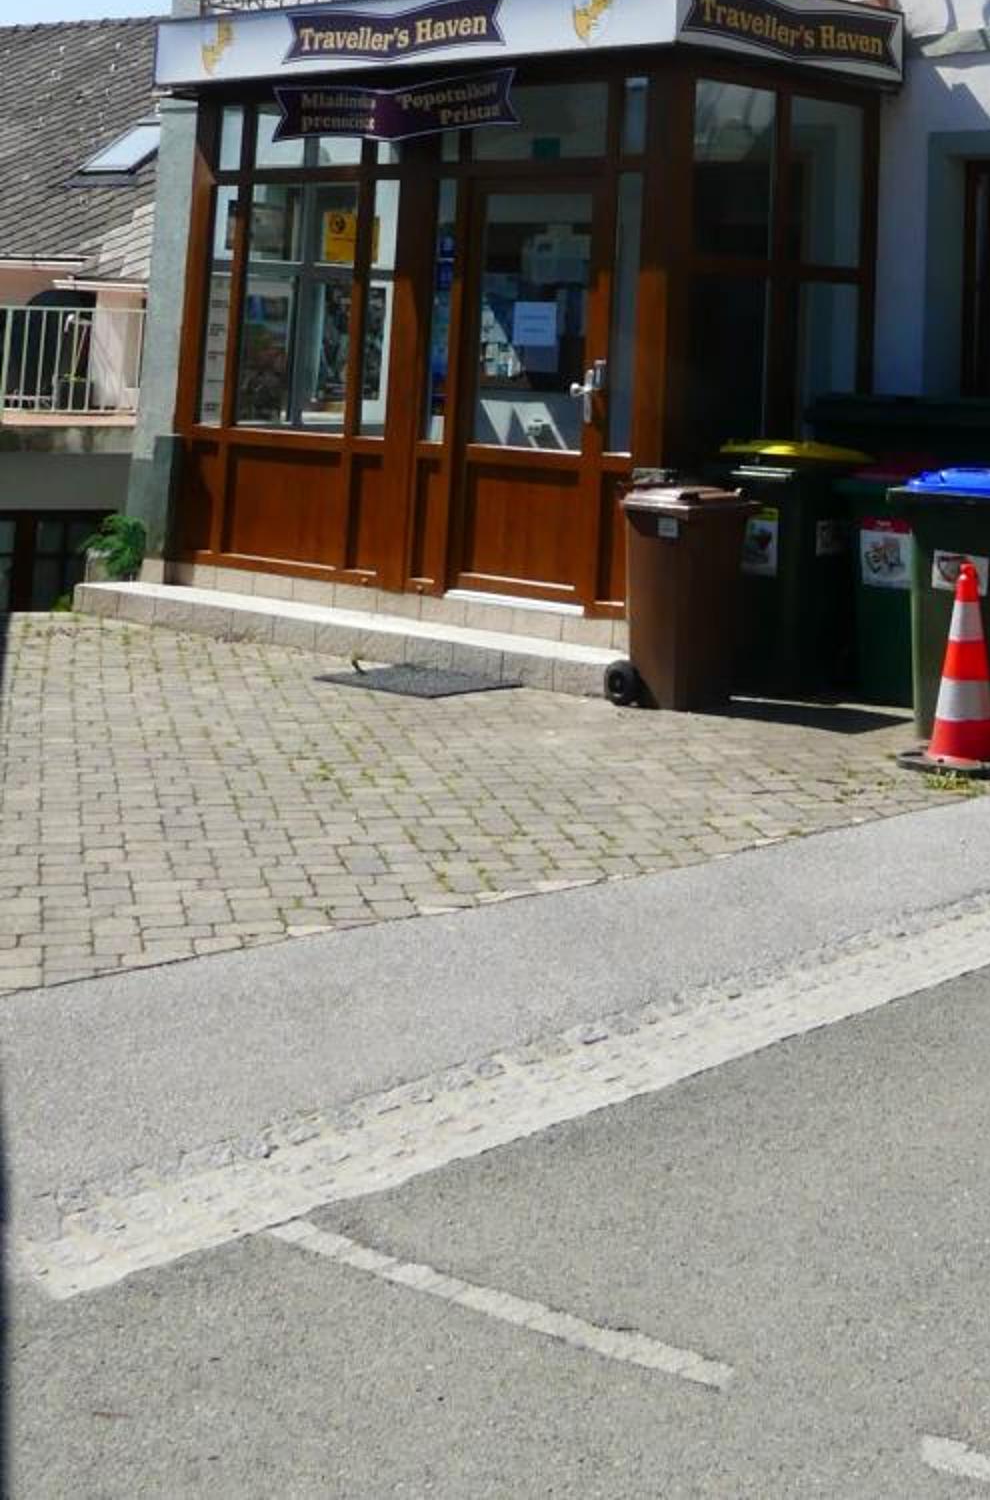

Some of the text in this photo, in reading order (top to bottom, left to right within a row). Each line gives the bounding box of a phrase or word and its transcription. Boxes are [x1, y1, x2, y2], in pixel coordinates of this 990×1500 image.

[300, 14, 487, 52] Traveller's Haven
[820, 25, 883, 56] Haven
